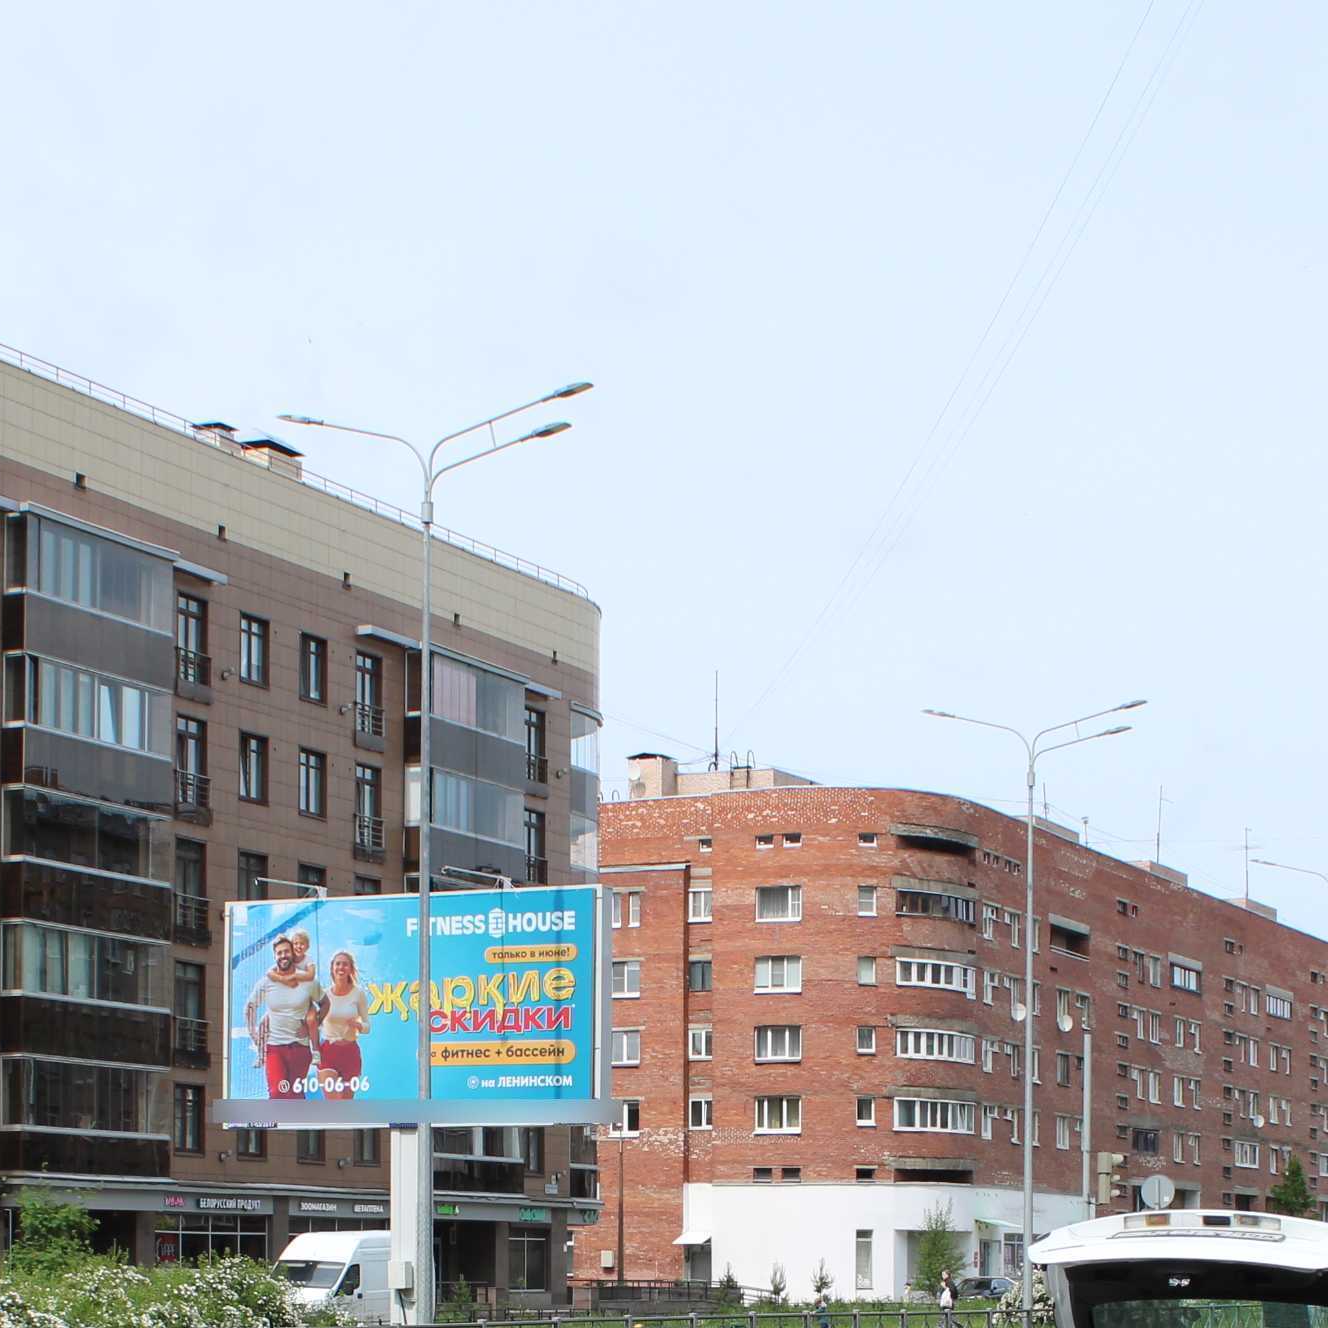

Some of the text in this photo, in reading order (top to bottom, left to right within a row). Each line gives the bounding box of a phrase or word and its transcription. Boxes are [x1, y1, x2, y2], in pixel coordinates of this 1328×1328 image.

[406, 911, 576, 937] FTNESS HOUSE
[492, 951, 527, 959] только
[539, 947, 570, 958] июне!
[367, 967, 576, 1020] жаркие
[429, 1006, 573, 1034] скидки
[441, 1046, 491, 1063] фитнес
[508, 1044, 565, 1058] бассейн
[292, 1076, 370, 1094] 610-06-06
[481, 1075, 573, 1088] на ЛЕНИНСКОМ
[199, 1197, 236, 1209] БЕЛОРУССКИЙ
[237, 1198, 262, 1210] ПРОДУКТ
[300, 1202, 337, 1212] ЗООМАГАЗИН
